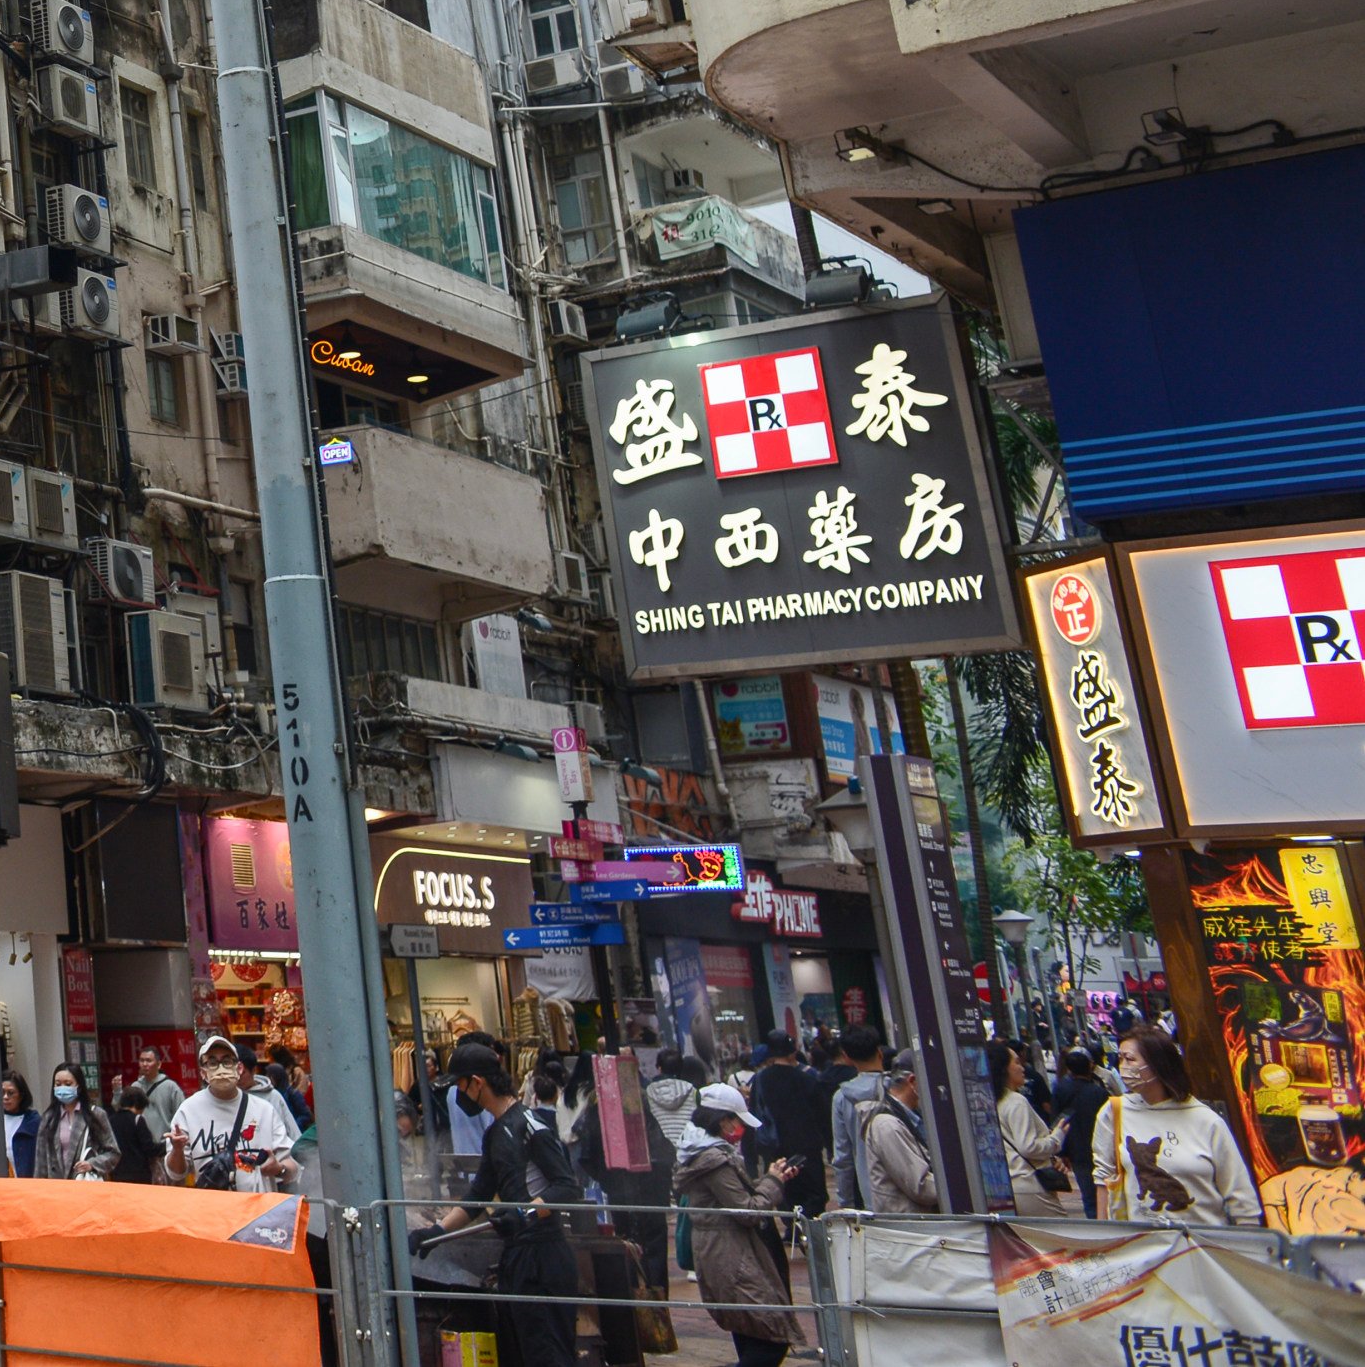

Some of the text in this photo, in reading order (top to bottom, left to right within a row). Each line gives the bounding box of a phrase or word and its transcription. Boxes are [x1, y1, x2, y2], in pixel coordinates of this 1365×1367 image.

[608, 379, 704, 486] 盛
[845, 343, 949, 447] 泰
[324, 448, 348, 459] OPEN
[628, 473, 965, 593] 中西藥房
[634, 575, 984, 634] SHING TAI PHARMACY COMPANY
[1063, 602, 1090, 637] 正
[740, 682, 780, 695] rabbit
[1070, 650, 1143, 827] 盛泰
[413, 870, 495, 910] FOCUS.S
[1301, 854, 1339, 945] 忠興堂
[772, 893, 821, 934] PHONE
[66, 955, 90, 974] Nail
[68, 975, 90, 992] Box
[179, 1039, 195, 1054] Nail
[181, 1063, 197, 1079] Box
